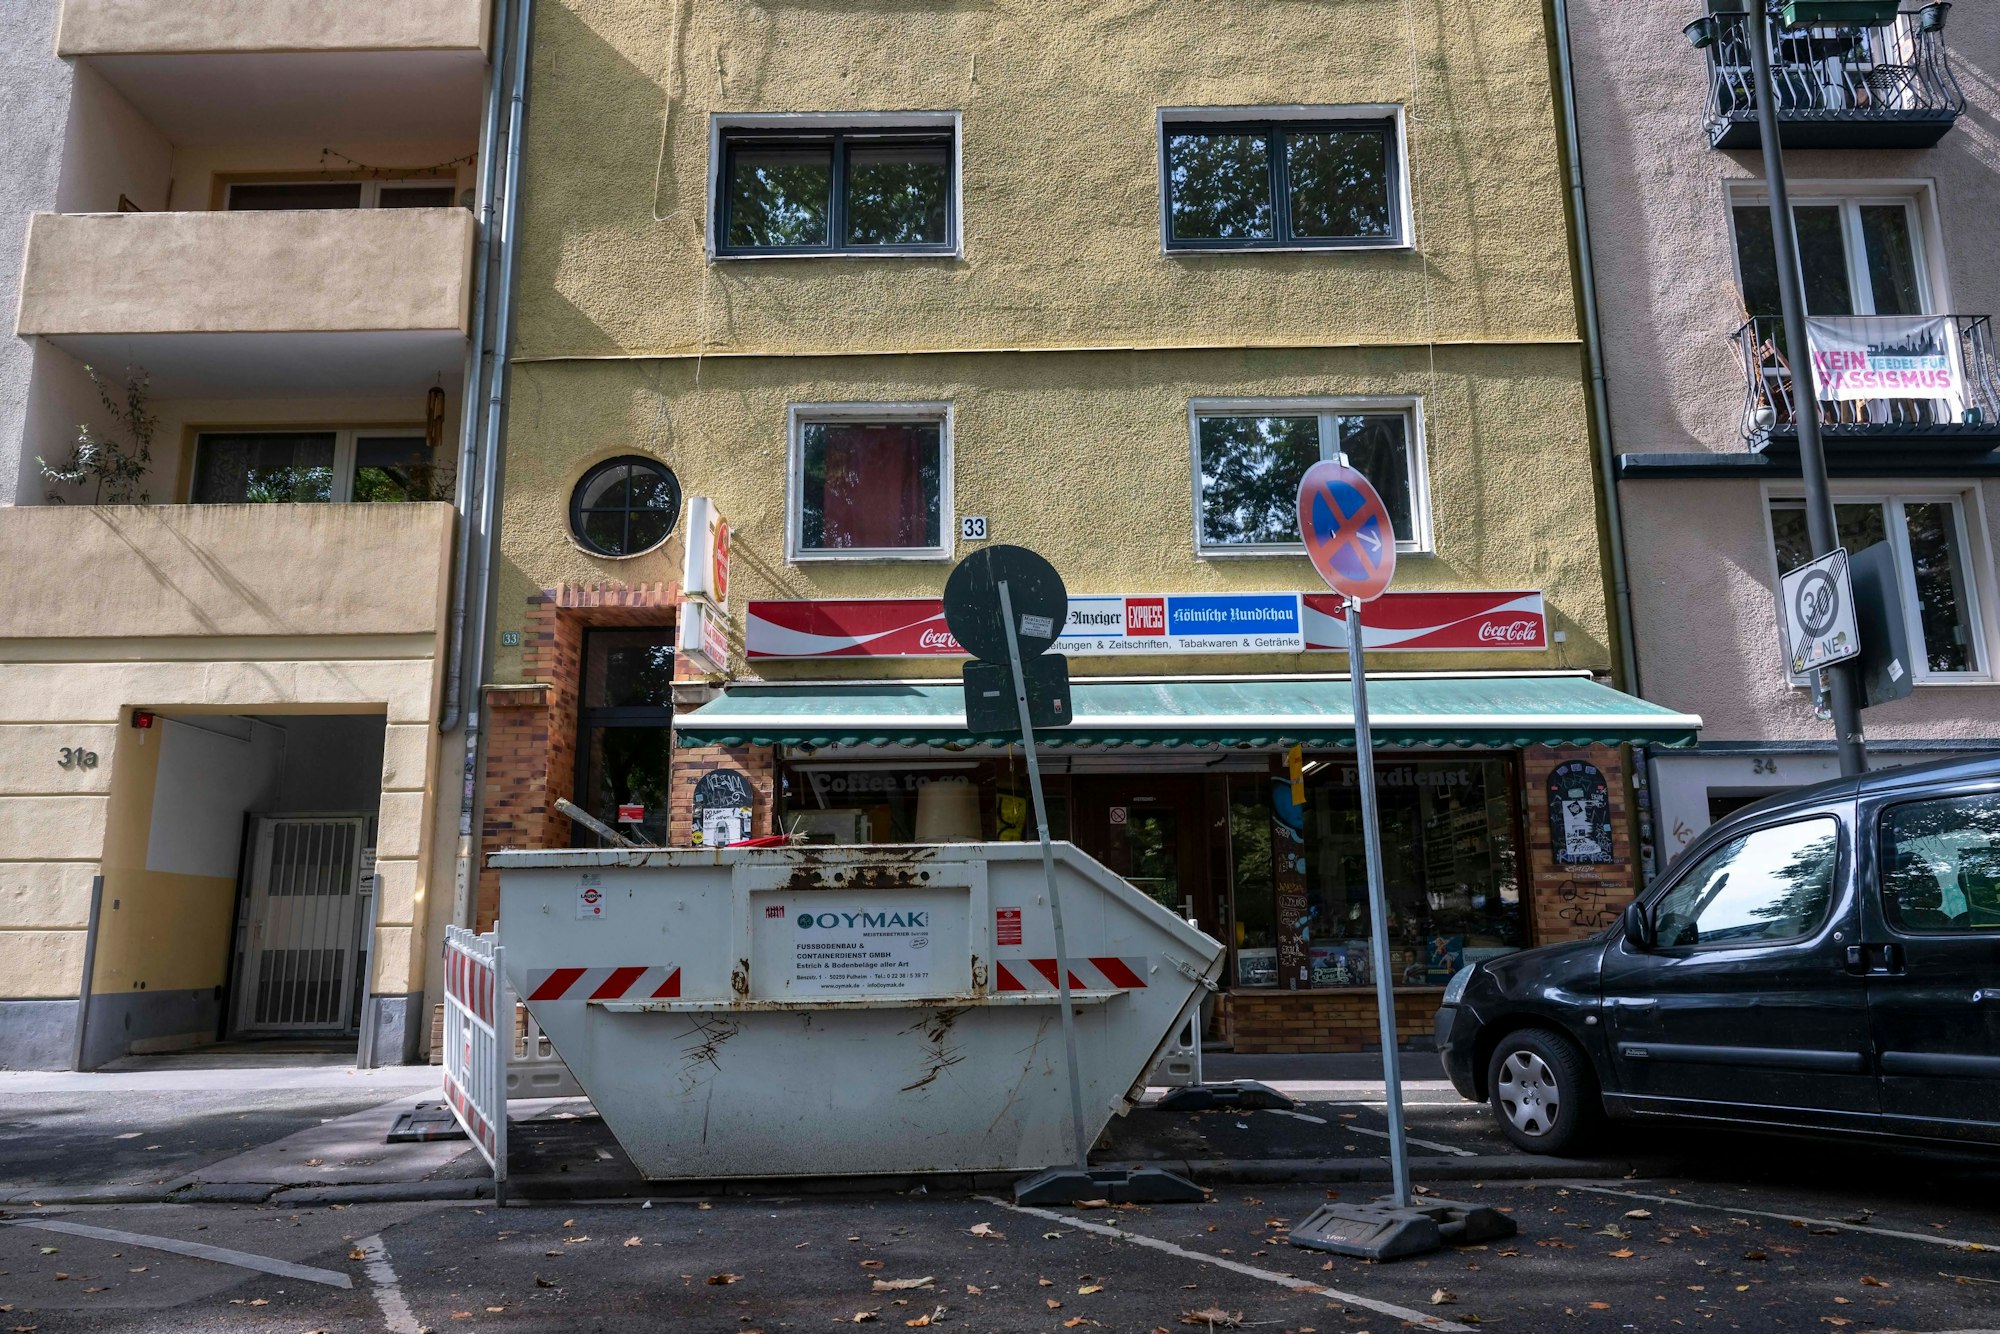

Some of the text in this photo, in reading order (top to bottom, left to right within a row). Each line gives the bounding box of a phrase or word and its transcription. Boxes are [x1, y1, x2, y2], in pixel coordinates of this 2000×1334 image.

[1814, 351, 1947, 370] KEIN VEEDEL FÜR
[1818, 370, 1951, 389] RASSISMUS
[964, 518, 985, 537] 33
[1803, 585, 1830, 622] 30
[1065, 605, 1164, 629] -Anzeiger EXPRESS
[504, 633, 517, 644] 33
[1478, 620, 1538, 642] Coca-Cola
[1048, 637, 1300, 651] eitungen & Zeitschriften, Tabakwaren & Getränke
[1808, 635, 1841, 662] ZNE
[57, 746, 99, 769] 31a
[1753, 758, 1777, 774] 34
[814, 773, 897, 793] Coffee
[903, 773, 930, 792] to
[1341, 767, 1471, 787] Fxdienst
[816, 911, 926, 929] OYMAK
[796, 952, 867, 960] CONTAINERDIENST
[831, 961, 878, 970] Bodenbeläge
